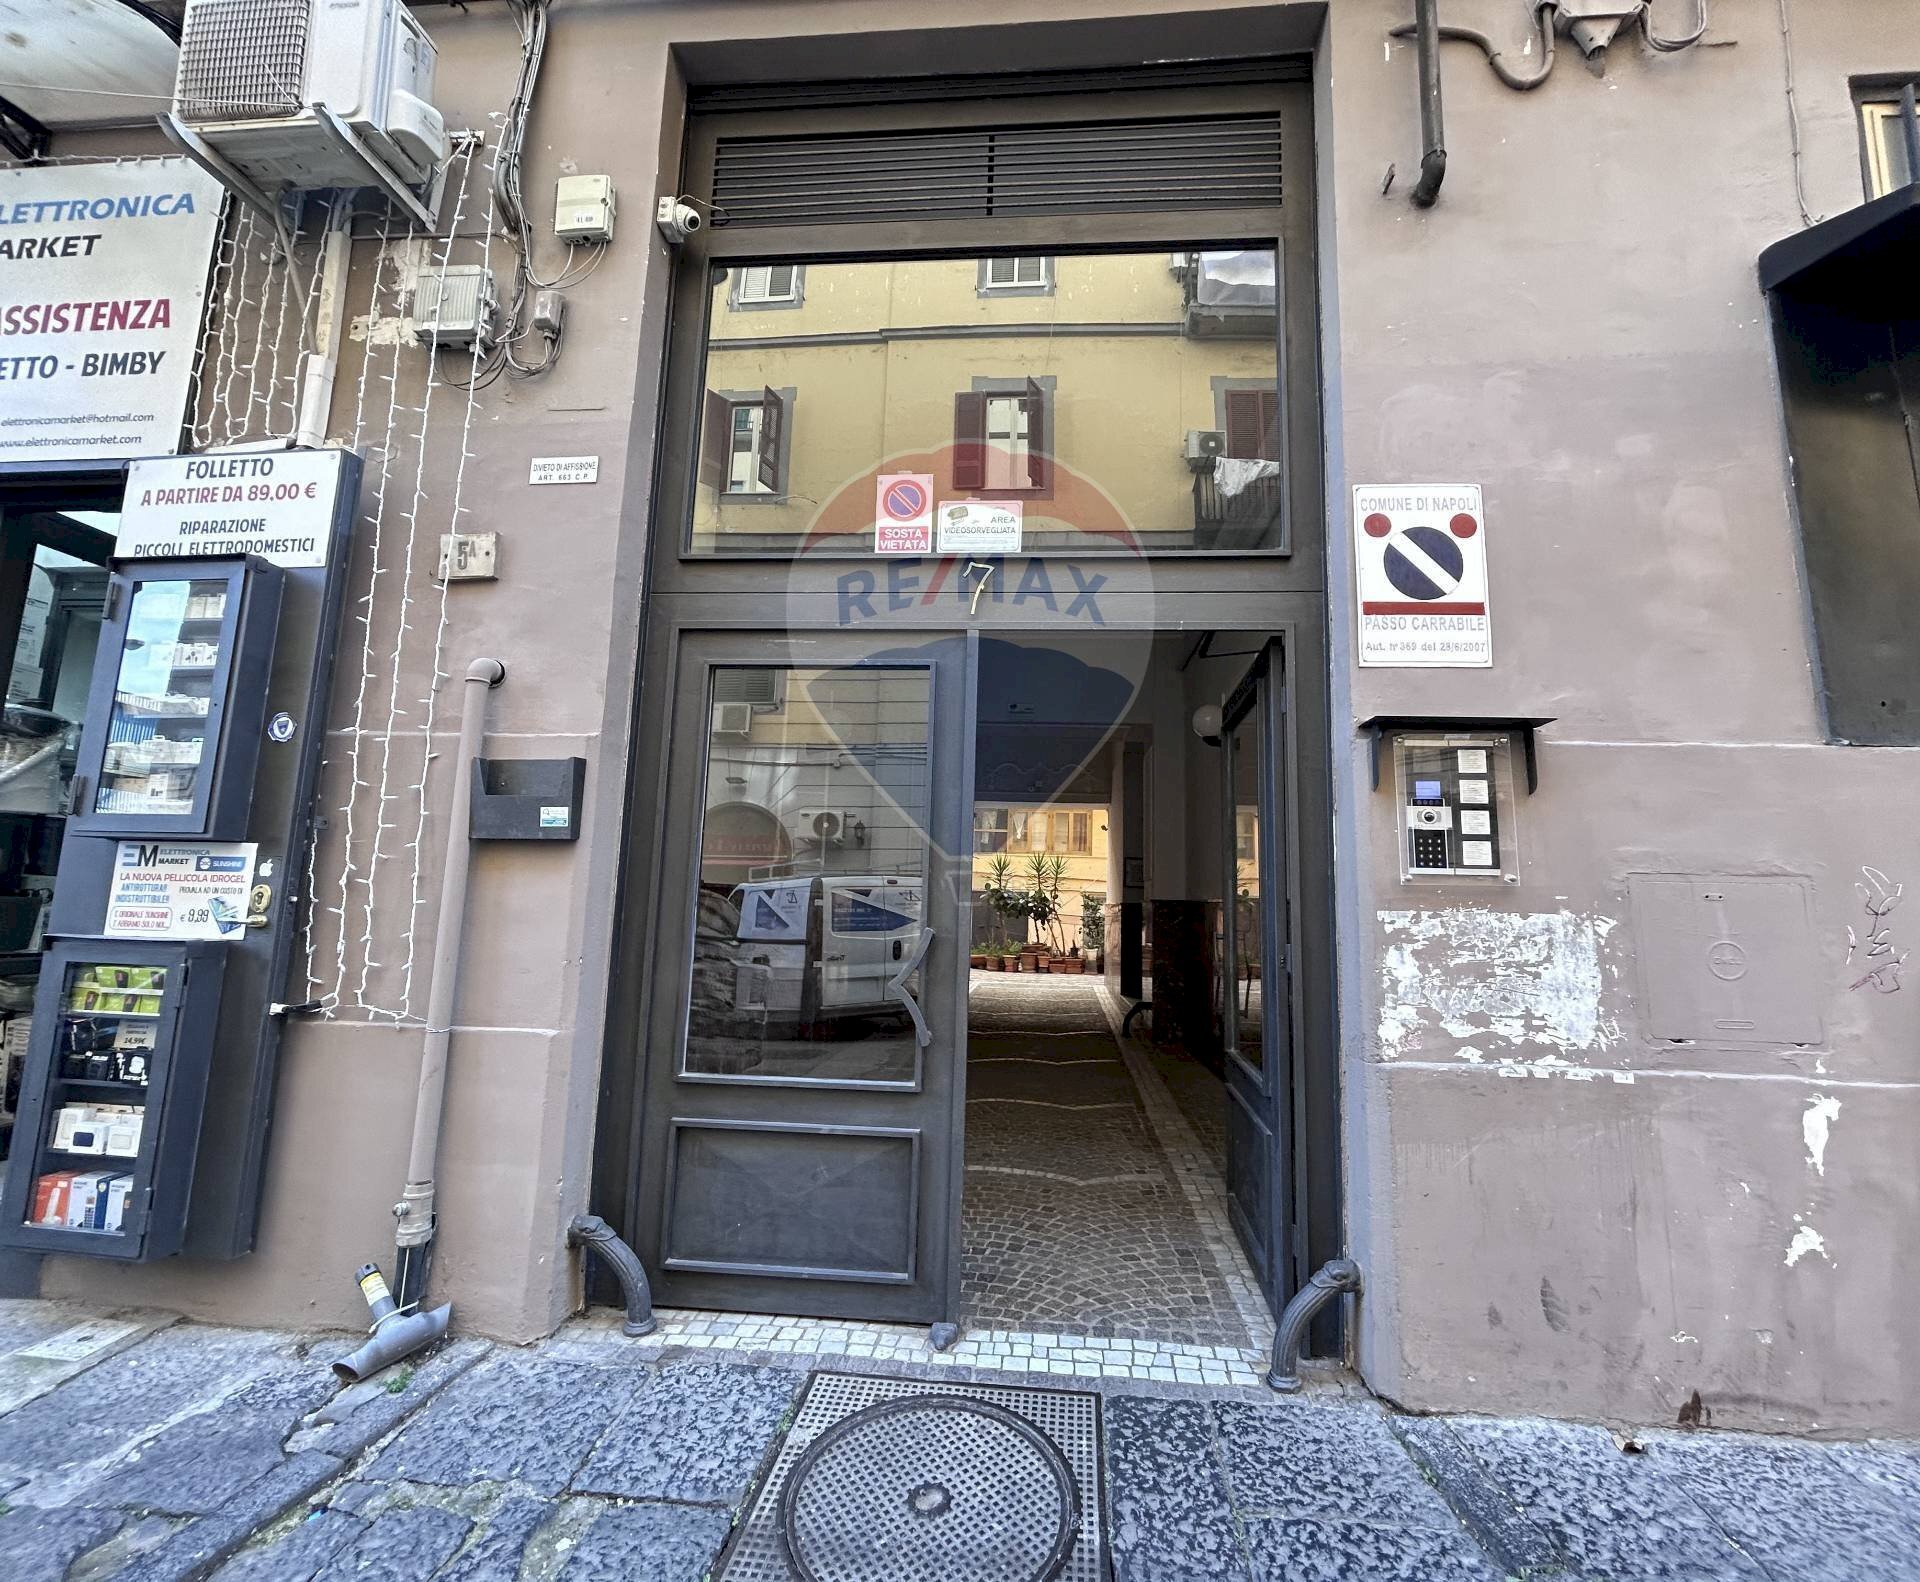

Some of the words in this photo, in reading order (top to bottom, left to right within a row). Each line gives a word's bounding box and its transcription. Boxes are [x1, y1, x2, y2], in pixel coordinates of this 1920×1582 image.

[0, 299, 170, 336] SSISTENZA
[81, 351, 166, 377] BIMBY
[186, 458, 274, 480] FOLLETTO
[533, 463, 555, 472] DIVIETO
[556, 463, 562, 471] DI
[563, 461, 596, 471] AFFISSIONE
[140, 490, 151, 507] A
[155, 487, 219, 505] PARTIRE
[222, 486, 243, 502] DA
[247, 483, 299, 501] 89.00
[304, 482, 317, 499] €
[1361, 498, 1412, 511] COMUNE
[1417, 498, 1428, 511] DI
[1433, 497, 1477, 511] NAPOLI
[990, 516, 1016, 524] AREA
[179, 518, 267, 535] RIPARAZIONE
[944, 526, 1016, 534] VIDEOSORVEGLIATA
[884, 528, 923, 539] SOSTA
[135, 542, 183, 558] PICCOLI
[188, 538, 315, 555] ELETTRODOMESTICI
[880, 539, 927, 550] VIETATA
[962, 562, 996, 615] 7
[1365, 616, 1407, 631] PASSO
[1412, 616, 1485, 631] CARRABILE
[1366, 642, 1385, 651] Aut.
[1421, 641, 1436, 651] del
[160, 848, 210, 856] ELETTRONICA
[212, 860, 243, 868] SUNSHINE
[120, 873, 130, 881] LA
[132, 873, 162, 881] NUOVA
[164, 874, 207, 882] PELLICOLA
[210, 874, 245, 883] IDROGEL
[179, 886, 201, 894] PROVALA
